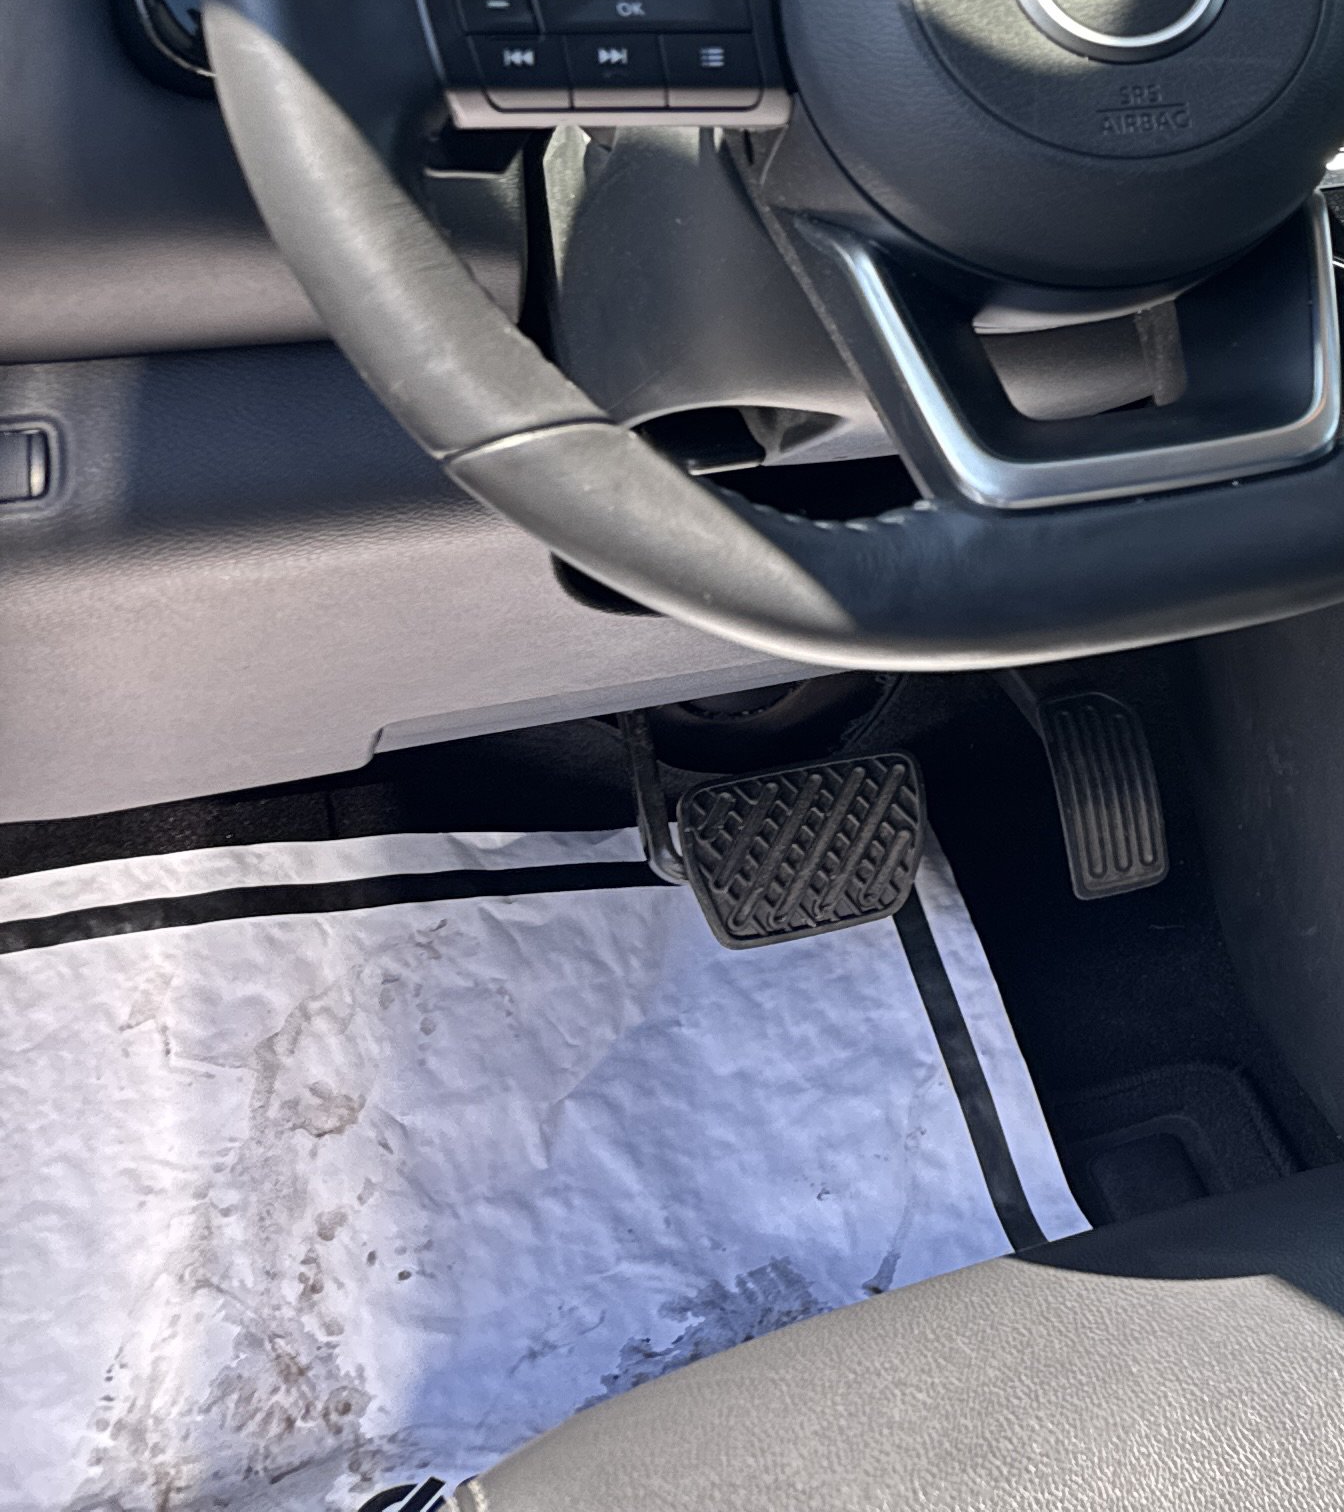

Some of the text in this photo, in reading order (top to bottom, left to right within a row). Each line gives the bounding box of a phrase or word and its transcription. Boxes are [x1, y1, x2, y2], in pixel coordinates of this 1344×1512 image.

[616, 0, 647, 19] OK
[1119, 84, 1163, 106] SRS
[1102, 110, 1193, 137] AIRBAG
